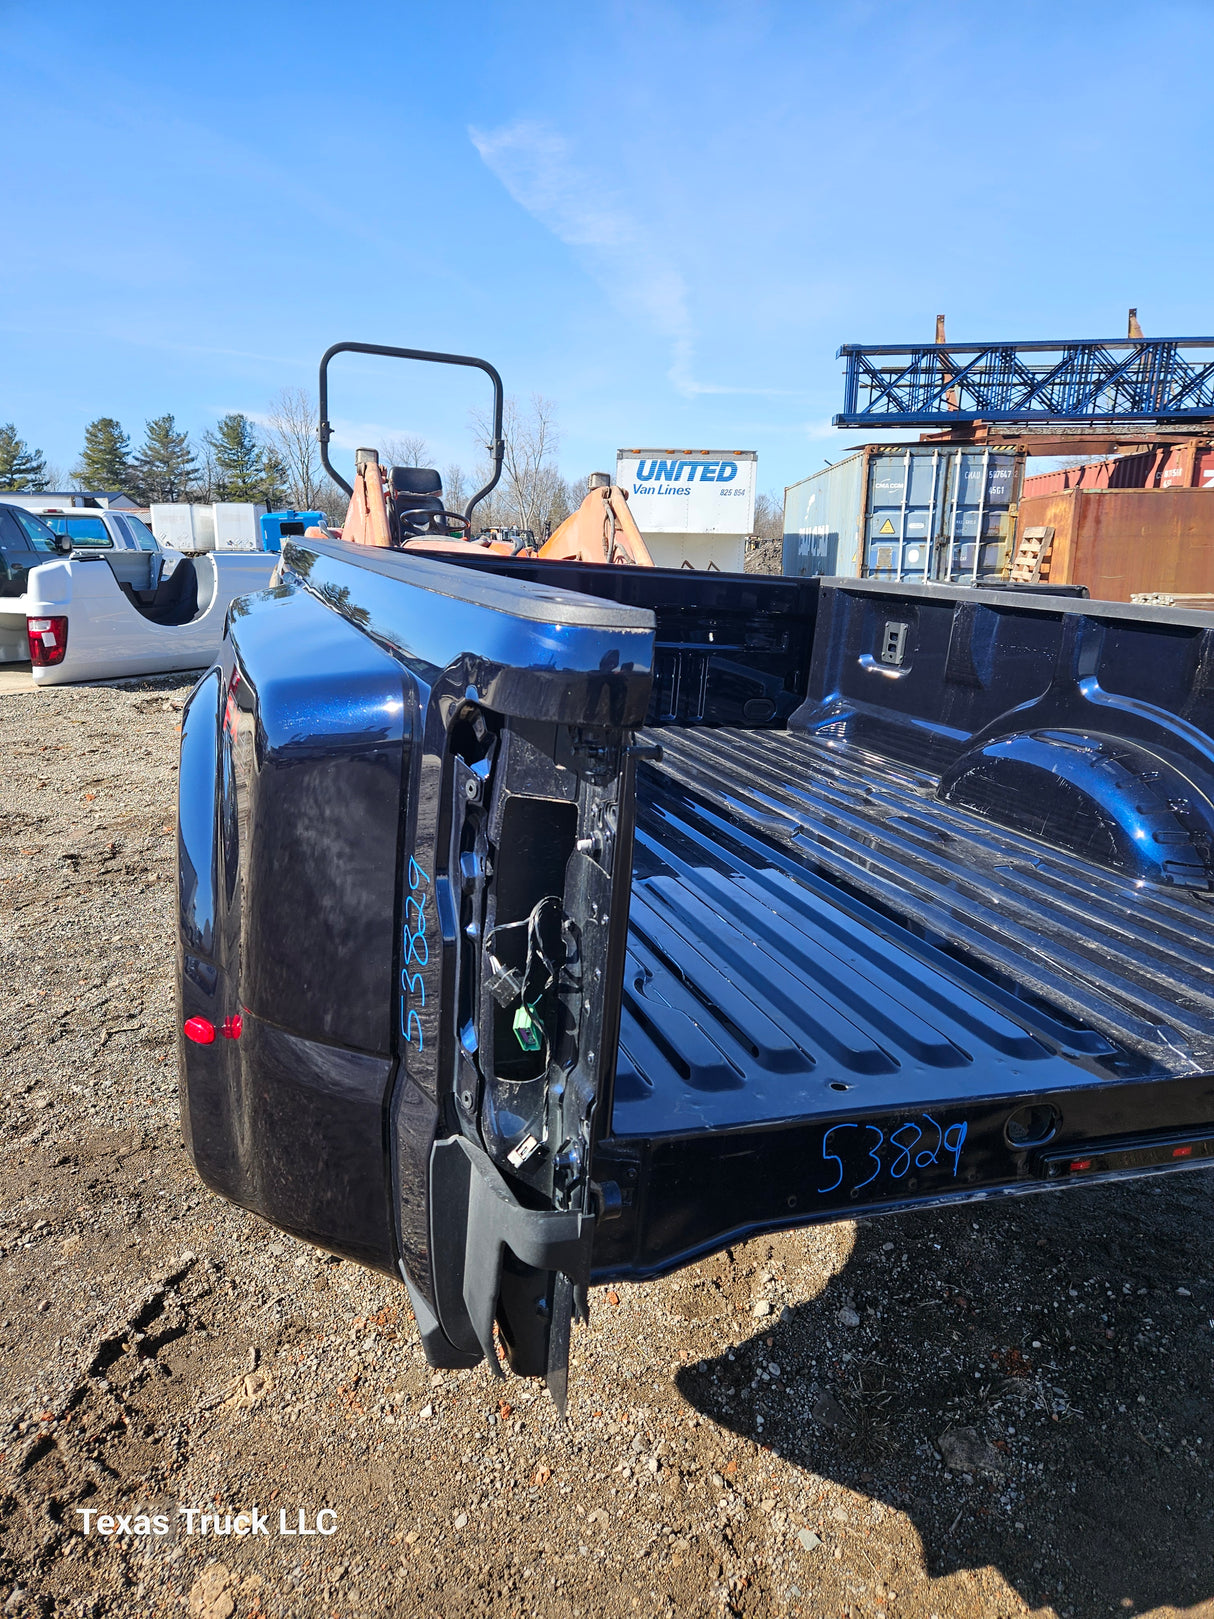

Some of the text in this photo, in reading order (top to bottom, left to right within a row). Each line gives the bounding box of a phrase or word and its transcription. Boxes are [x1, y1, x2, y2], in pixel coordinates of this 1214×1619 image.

[636, 459, 738, 482] UNITED
[633, 484, 691, 496] Van Lines
[720, 489, 732, 497] 825
[401, 854, 431, 1053] 53829
[817, 1113, 968, 1193] 53829
